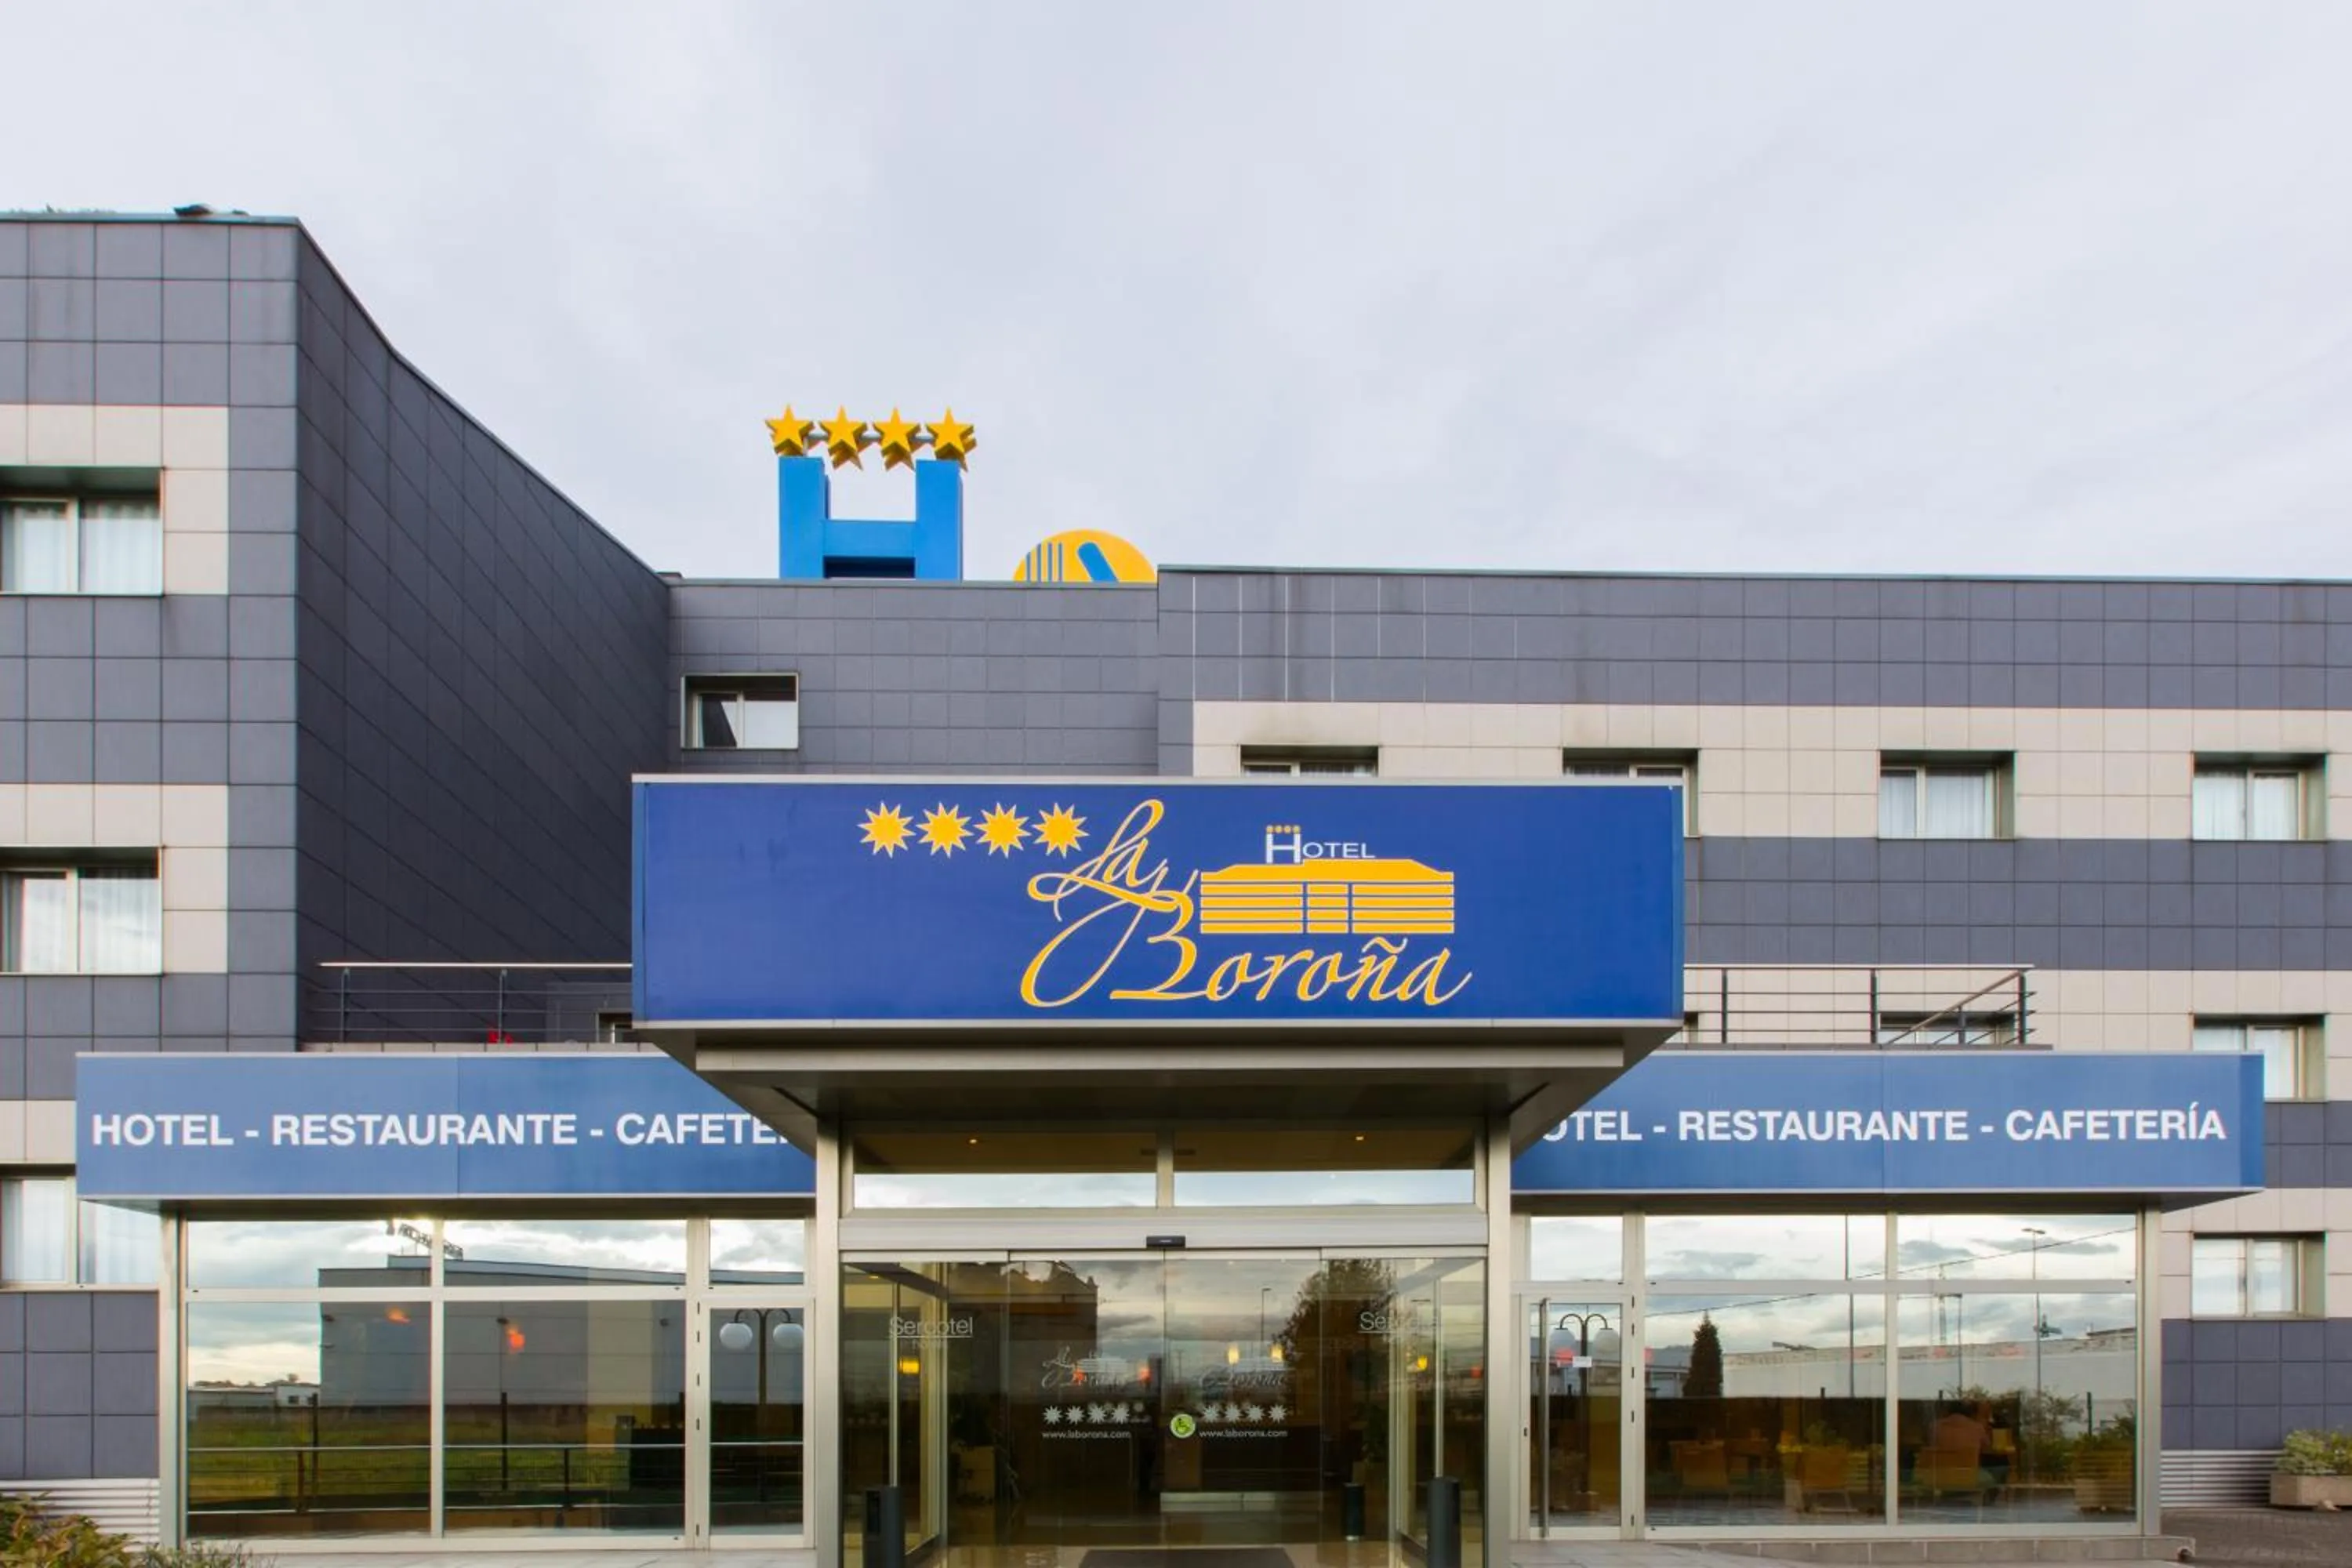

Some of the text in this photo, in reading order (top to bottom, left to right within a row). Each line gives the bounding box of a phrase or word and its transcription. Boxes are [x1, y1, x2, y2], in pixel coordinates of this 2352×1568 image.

[1021, 869, 1473, 1007] Boroña
[91, 1113, 234, 1145] HOTEL
[272, 1113, 578, 1146] RESTAURANTE
[615, 1112, 788, 1145] CAFETE
[1679, 1109, 1969, 1142] RESTAURANTE
[2005, 1102, 2227, 1141] CAFETERÍA
